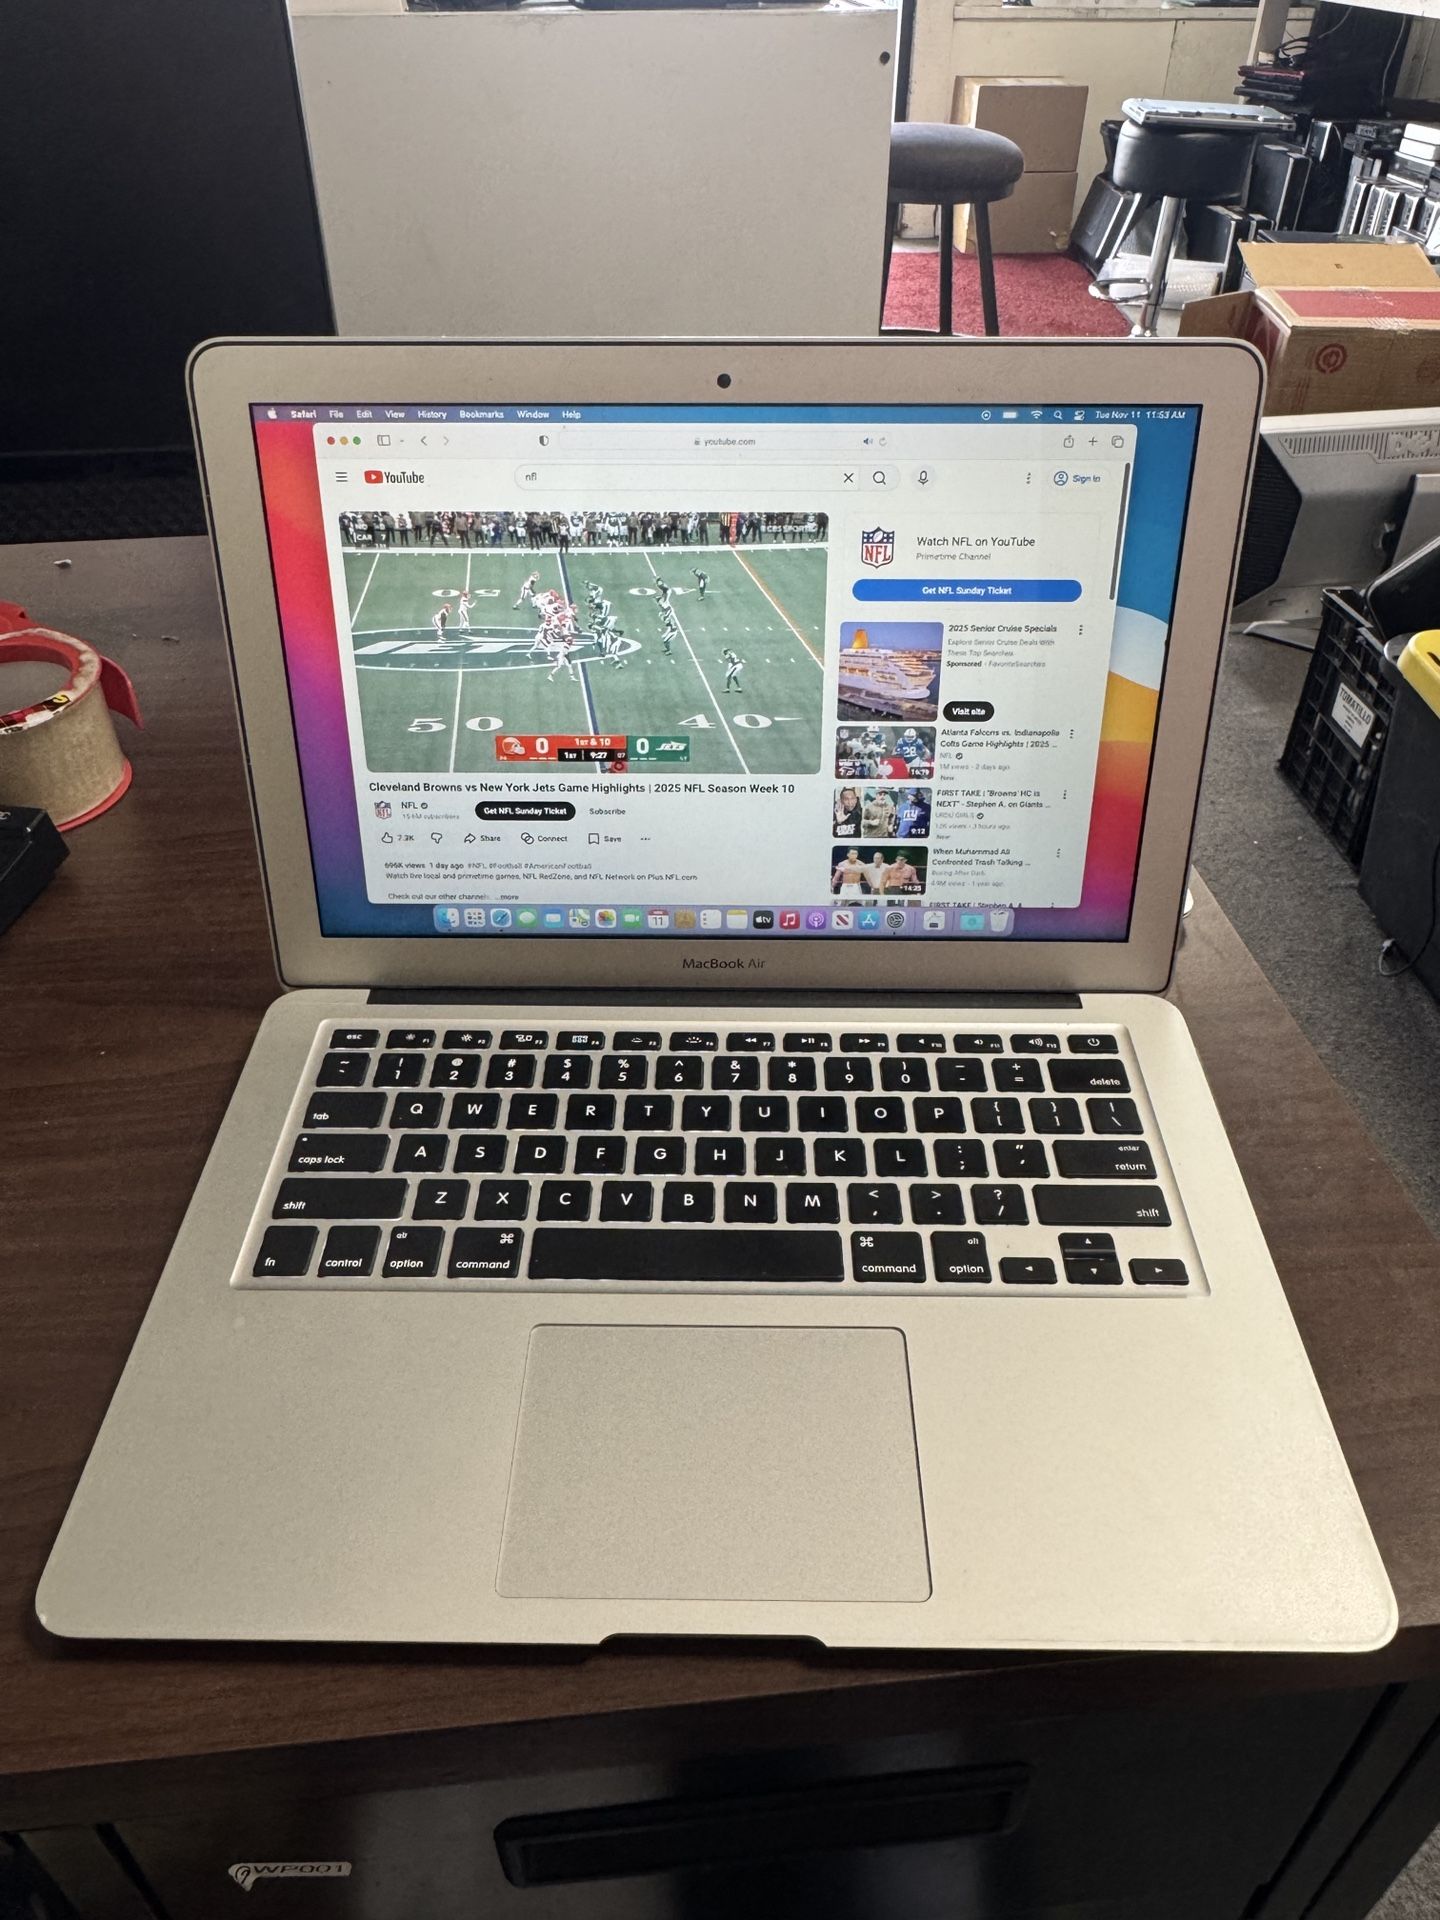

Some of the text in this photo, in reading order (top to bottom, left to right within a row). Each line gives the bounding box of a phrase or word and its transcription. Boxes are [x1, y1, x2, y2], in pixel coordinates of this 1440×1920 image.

[291, 410, 581, 420] Safari File Edit View History Bookmarks Window Help
[1095, 411, 1186, 419] Tue Nov 11:53 AM
[704, 438, 756, 447] youtube.com
[384, 472, 425, 484] YouTube
[525, 472, 537, 481] nfl
[1073, 475, 1091, 484] Sign
[917, 537, 949, 546] Watch
[951, 537, 972, 546] NFL
[991, 537, 1035, 547] YouTube
[864, 545, 891, 563] NFL
[916, 553, 957, 561] Primetime
[922, 587, 1012, 596] Get NFL Sunday Ticket
[1024, 625, 1057, 633] Specials
[952, 707, 969, 716] Visit
[1014, 729, 1060, 737] Indianapolis
[536, 738, 549, 753] 0
[599, 738, 611, 746] 10
[636, 738, 649, 753] 0
[985, 740, 1024, 749] Highlights
[369, 783, 420, 792] Cleveland
[423, 783, 462, 792] Browns
[480, 783, 500, 792] New
[503, 783, 530, 792] York
[532, 783, 555, 792] Jets
[558, 783, 588, 792] Game
[592, 783, 645, 794] Highlights
[654, 784, 681, 793] 2025
[684, 784, 705, 793] NFL
[708, 784, 747, 793] Season
[750, 784, 779, 793] Week
[782, 784, 795, 793] 10
[966, 801, 996, 809] Stephen
[484, 807, 567, 816] Get NFL Sunday Ticket
[998, 859, 1023, 867] Talking
[458, 873, 494, 881] primetime
[539, 873, 573, 881] RedZone,
[653, 917, 663, 926] 11
[682, 958, 768, 969] MacBook Air
[395, 1071, 401, 1080] 1
[449, 1071, 459, 1080] 2
[505, 1071, 513, 1081] 3
[561, 1072, 571, 1082] 4
[617, 1072, 627, 1082] 5
[675, 1073, 683, 1083] 6
[731, 1073, 740, 1083] 7
[788, 1073, 797, 1083] 8
[845, 1074, 854, 1084] 9
[901, 1074, 910, 1084] 0
[1090, 1078, 1121, 1086] delete
[410, 1103, 424, 1115] Q
[467, 1104, 483, 1115] W
[528, 1105, 537, 1115] E
[586, 1105, 596, 1116] R
[644, 1105, 654, 1116] T
[701, 1106, 712, 1117] Y
[759, 1107, 771, 1118] U
[819, 1107, 825, 1118] I
[874, 1108, 887, 1119] O
[934, 1108, 945, 1119] P
[313, 1112, 329, 1121] tab
[415, 1147, 427, 1158] A
[475, 1147, 486, 1158] S
[535, 1147, 547, 1158] D
[596, 1148, 606, 1159] F
[654, 1148, 667, 1160] G
[714, 1150, 726, 1161] H
[776, 1150, 784, 1162] J
[835, 1150, 846, 1162] K
[896, 1150, 906, 1162] L
[298, 1155, 345, 1165] caps lock
[1115, 1162, 1147, 1171] return
[435, 1192, 448, 1204] Z
[496, 1192, 509, 1205] X
[559, 1193, 572, 1205] C
[621, 1193, 633, 1205] V
[684, 1194, 694, 1206] B
[744, 1195, 757, 1207] N
[804, 1195, 821, 1207] M
[283, 1201, 306, 1210] shift
[1136, 1208, 1159, 1218] shift
[265, 1257, 275, 1267] fn
[325, 1258, 362, 1268] control
[390, 1259, 423, 1269] option
[456, 1259, 510, 1269] command
[862, 1264, 917, 1274] command
[949, 1264, 984, 1276] option
[254, 1864, 343, 1874] WP001
